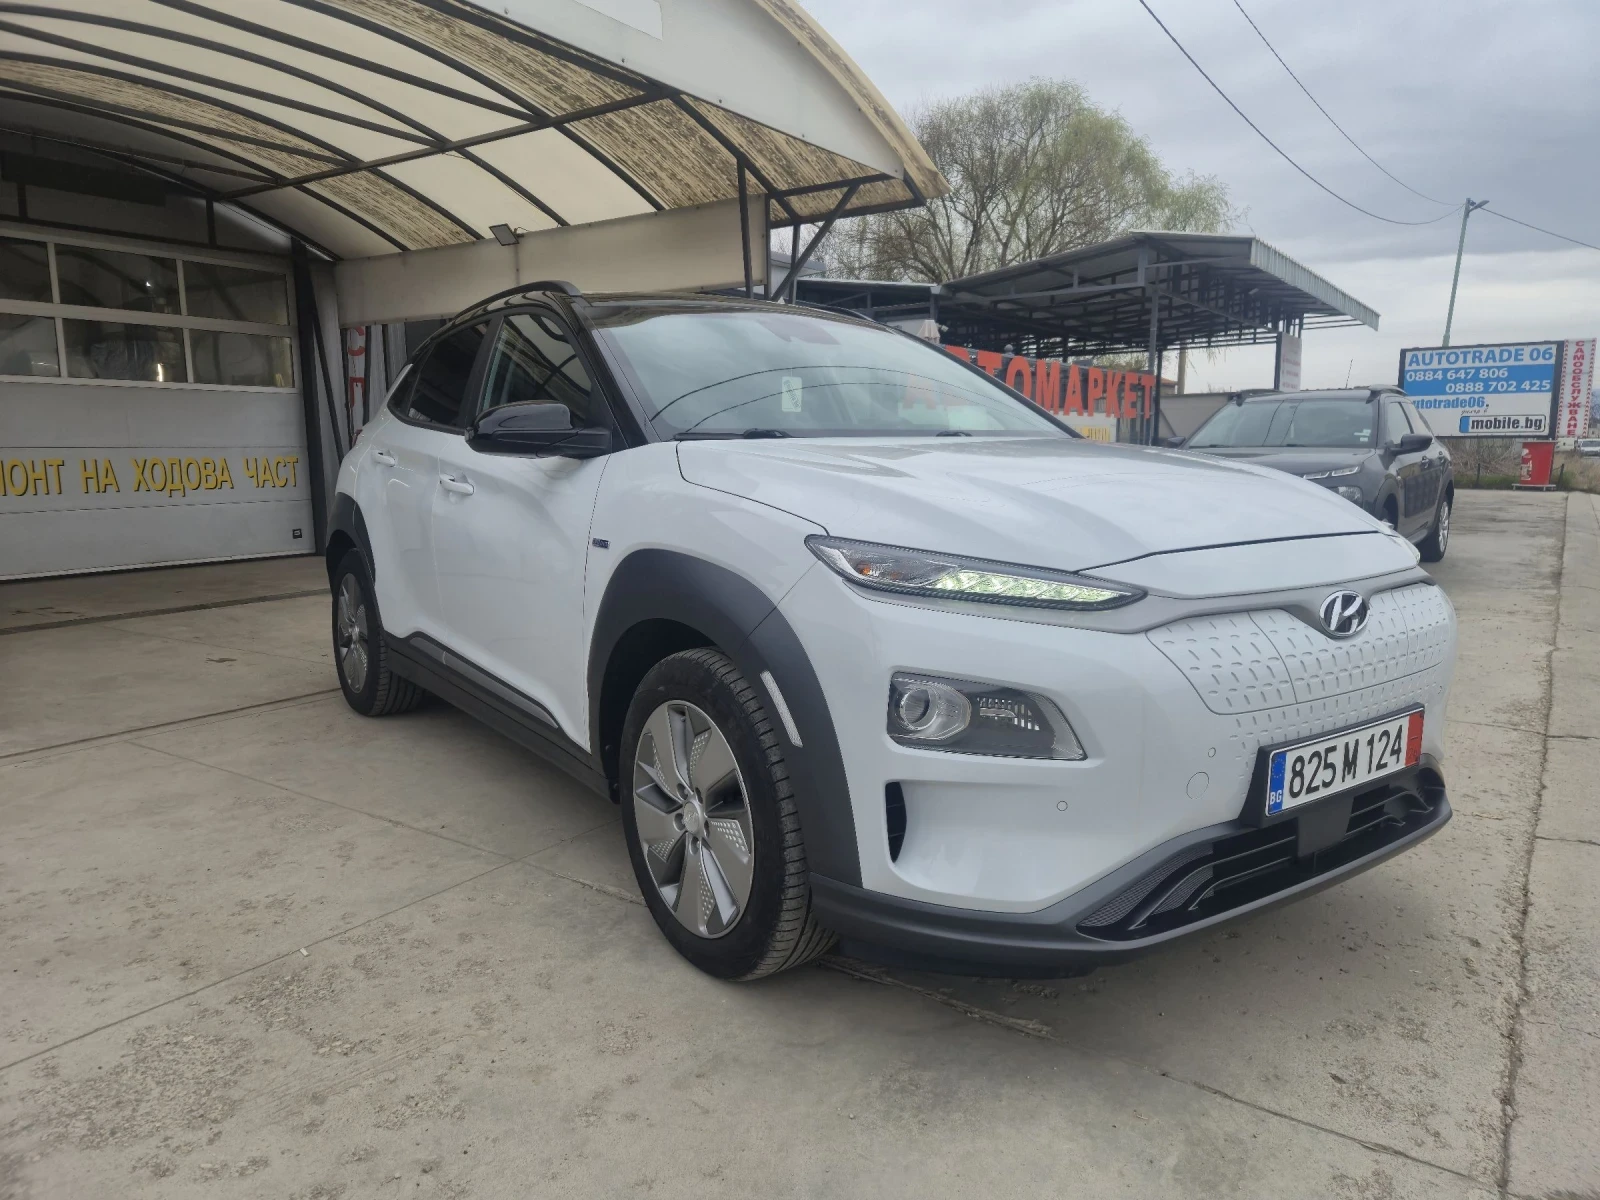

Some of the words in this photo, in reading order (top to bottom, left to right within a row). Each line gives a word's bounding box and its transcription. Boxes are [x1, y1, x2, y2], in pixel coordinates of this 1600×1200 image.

[1408, 348, 1524, 366] AUTOTRADE
[1529, 347, 1553, 361] 06
[1406, 371, 1443, 382] 0884
[1447, 369, 1476, 380] 647
[1479, 368, 1508, 379] 806
[1445, 382, 1484, 393] 0888
[1488, 381, 1516, 392] 702
[1520, 380, 1551, 391] 425
[1567, 340, 1584, 436] САМООБСЛУЖВАНЕ
[1471, 417, 1542, 430] mobile.bg
[0, 457, 65, 497] ОНТ
[79, 457, 121, 494] НА
[131, 455, 235, 498] ХОДОВА
[242, 455, 300, 488] ЧАСТ
[1289, 744, 1338, 798] 825
[1341, 738, 1360, 783] M
[1366, 724, 1403, 774] 124
[1269, 789, 1283, 805] BG
